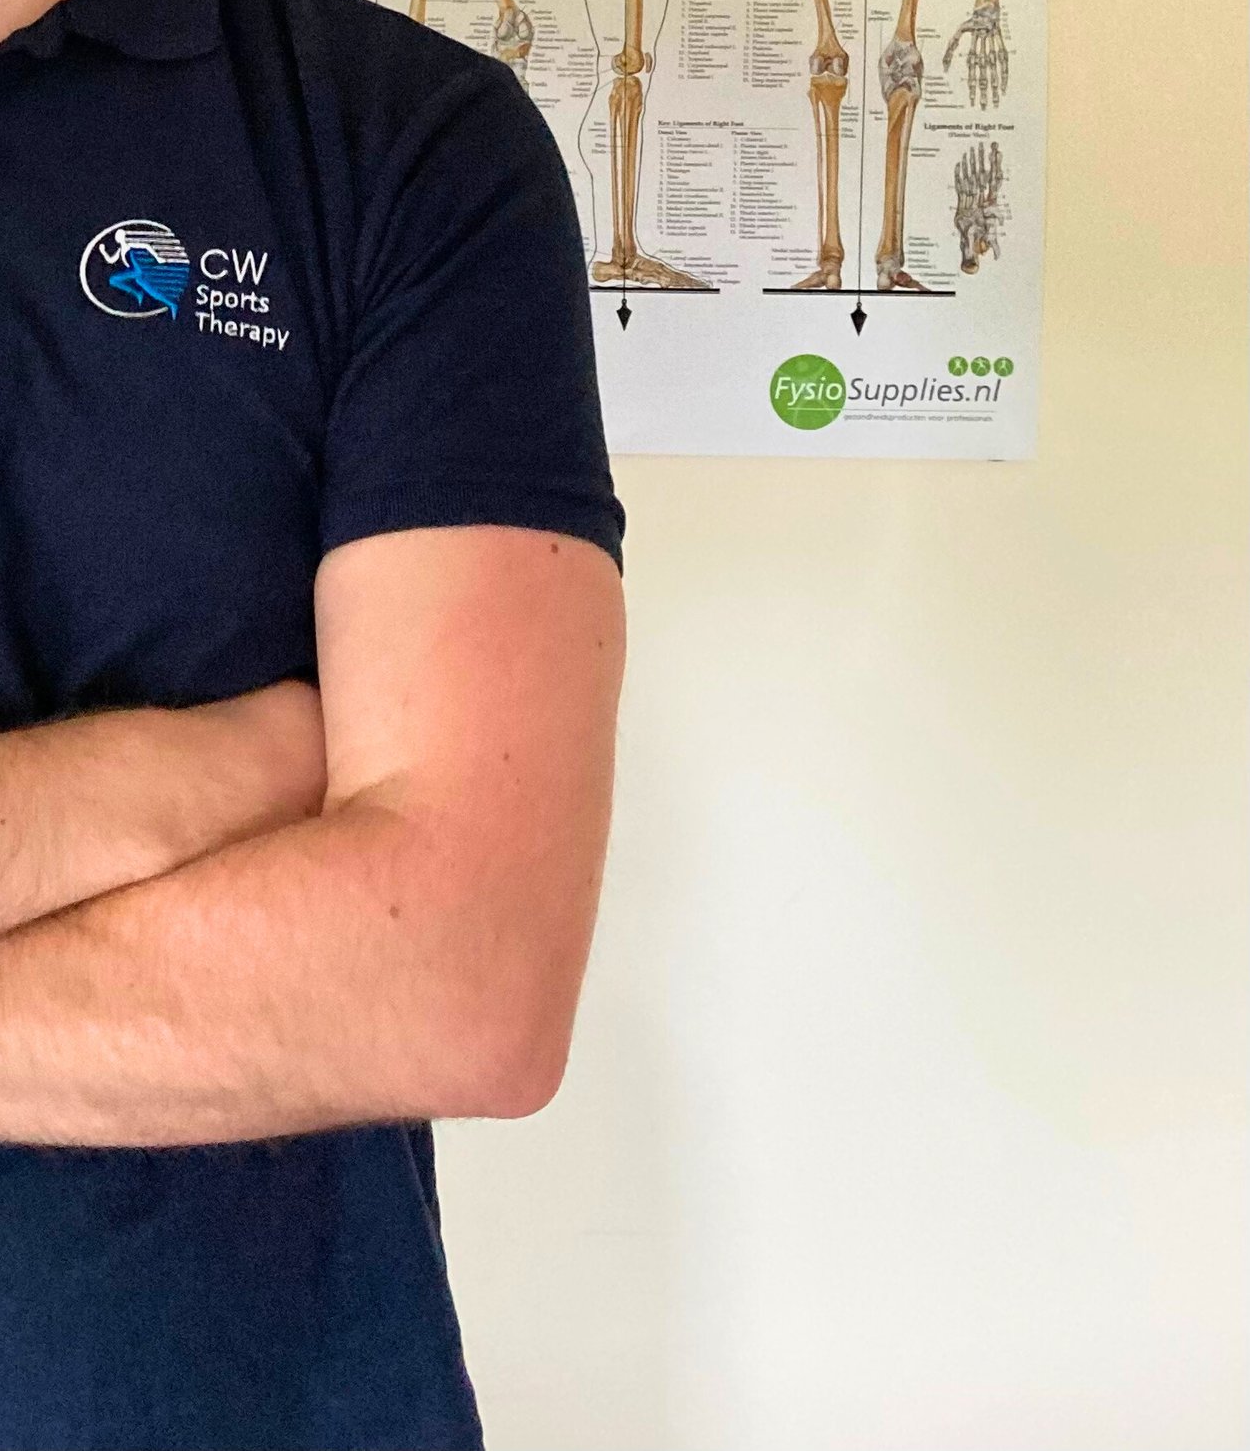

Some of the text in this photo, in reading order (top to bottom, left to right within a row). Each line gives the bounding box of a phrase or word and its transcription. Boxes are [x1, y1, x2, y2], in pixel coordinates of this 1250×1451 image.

[200, 248, 268, 286] CW
[196, 284, 270, 314] Sports
[195, 311, 290, 351] Therapy
[773, 377, 1002, 407] FysioSupplies.nl
